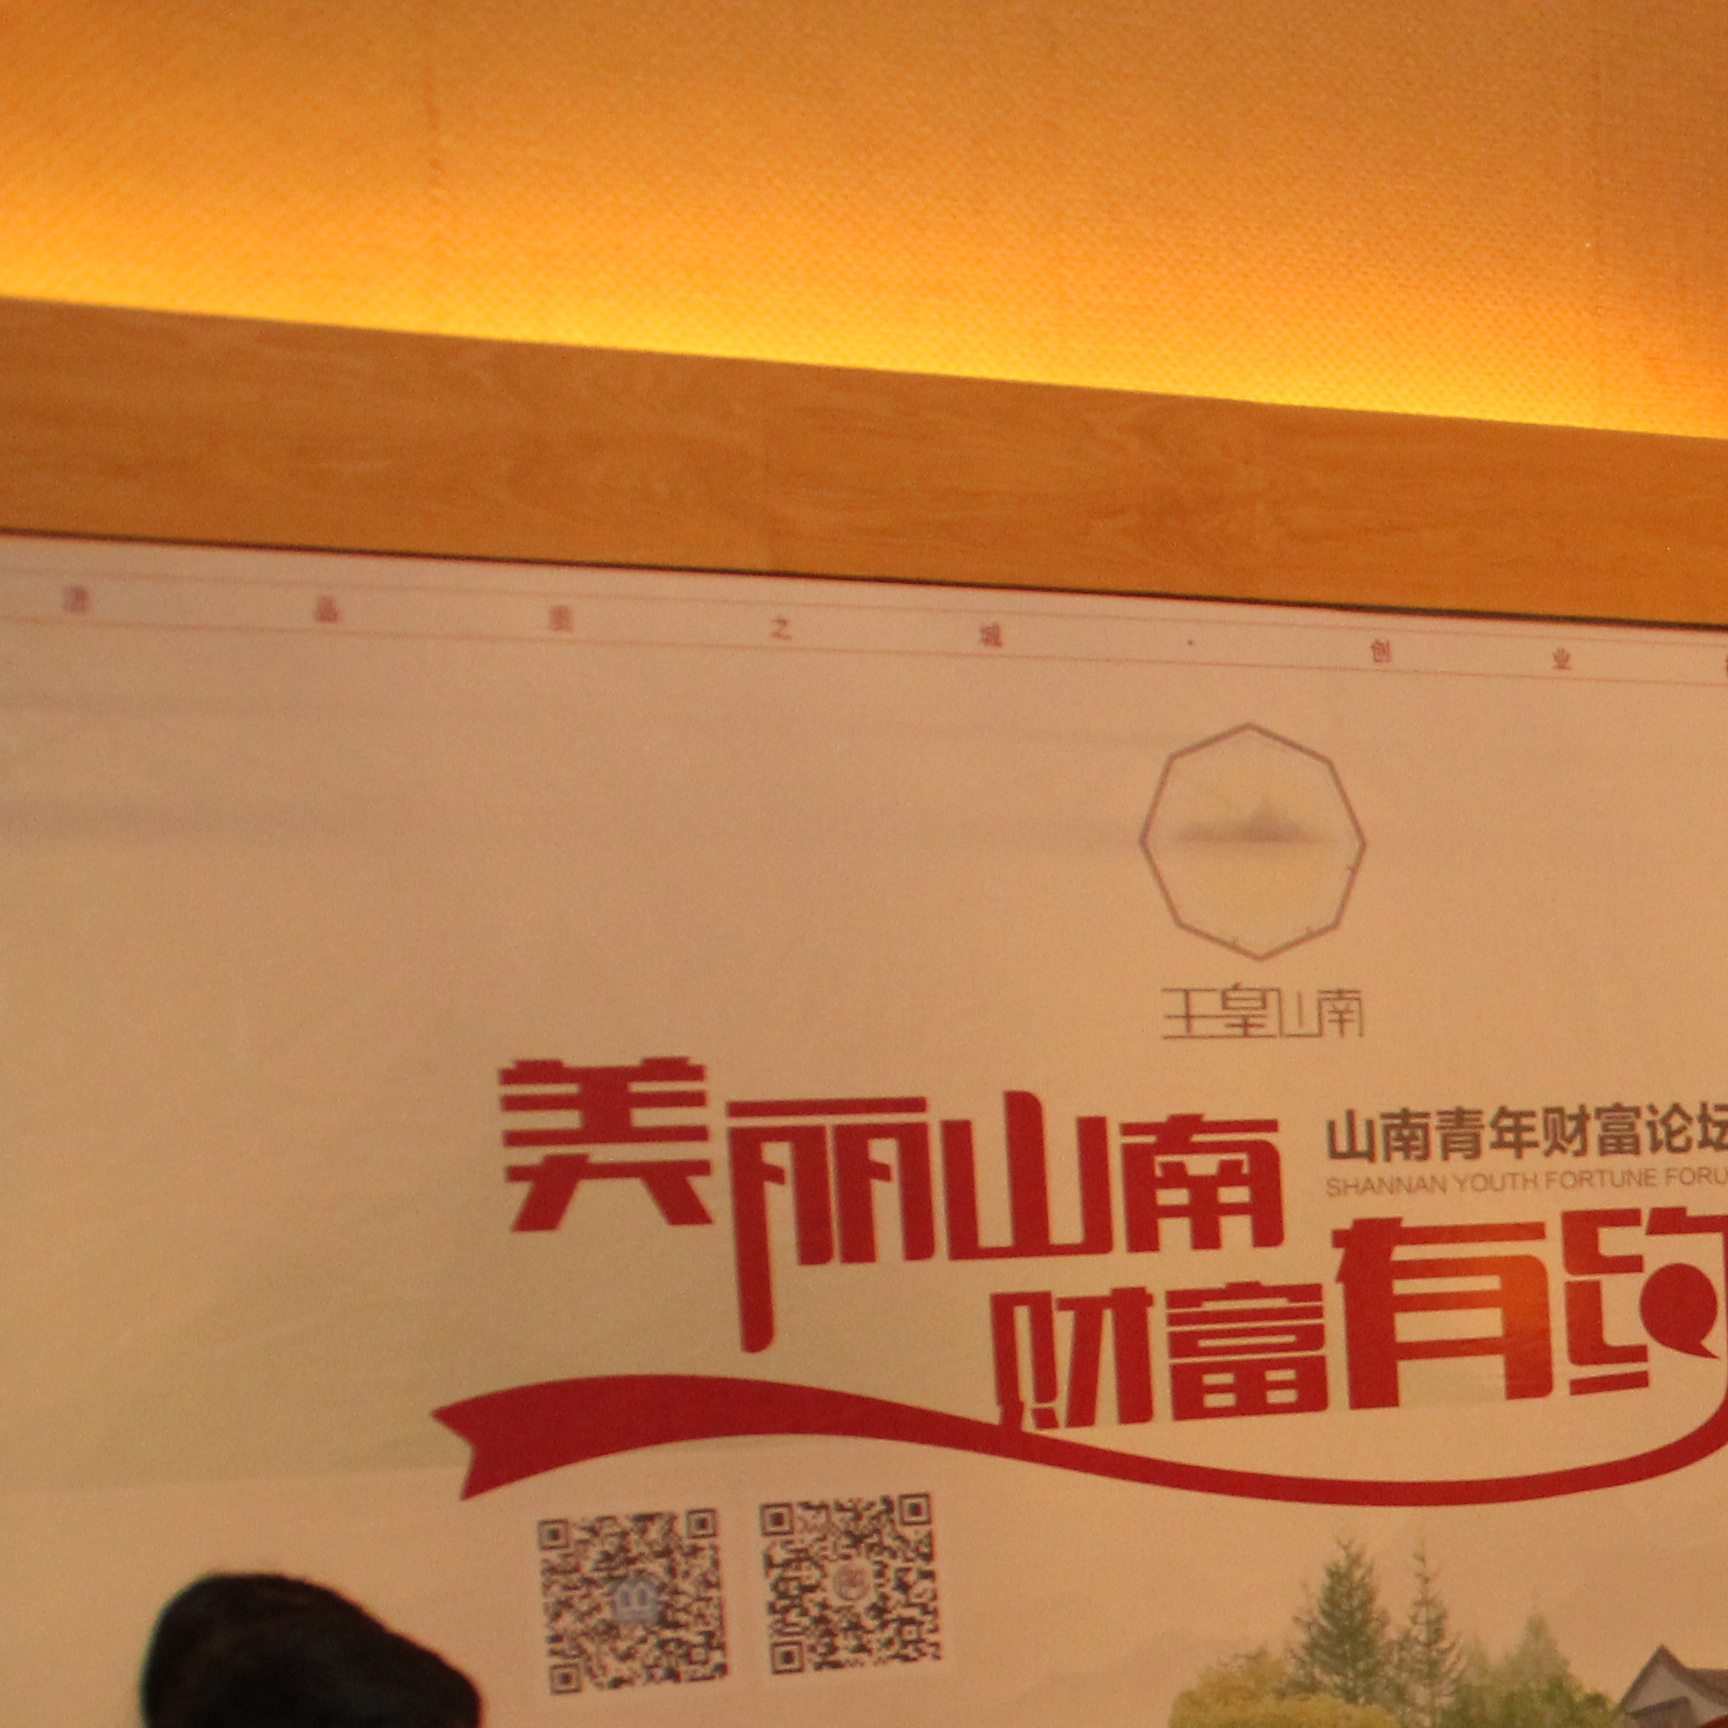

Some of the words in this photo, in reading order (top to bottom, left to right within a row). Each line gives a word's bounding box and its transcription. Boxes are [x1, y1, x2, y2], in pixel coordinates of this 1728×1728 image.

[498, 1056, 1284, 1354] 美丽山南
[1325, 1174, 1447, 1198] SHANNAN
[1453, 1171, 1540, 1194] YOUTH
[1544, 1167, 1658, 1191] FORTUNE
